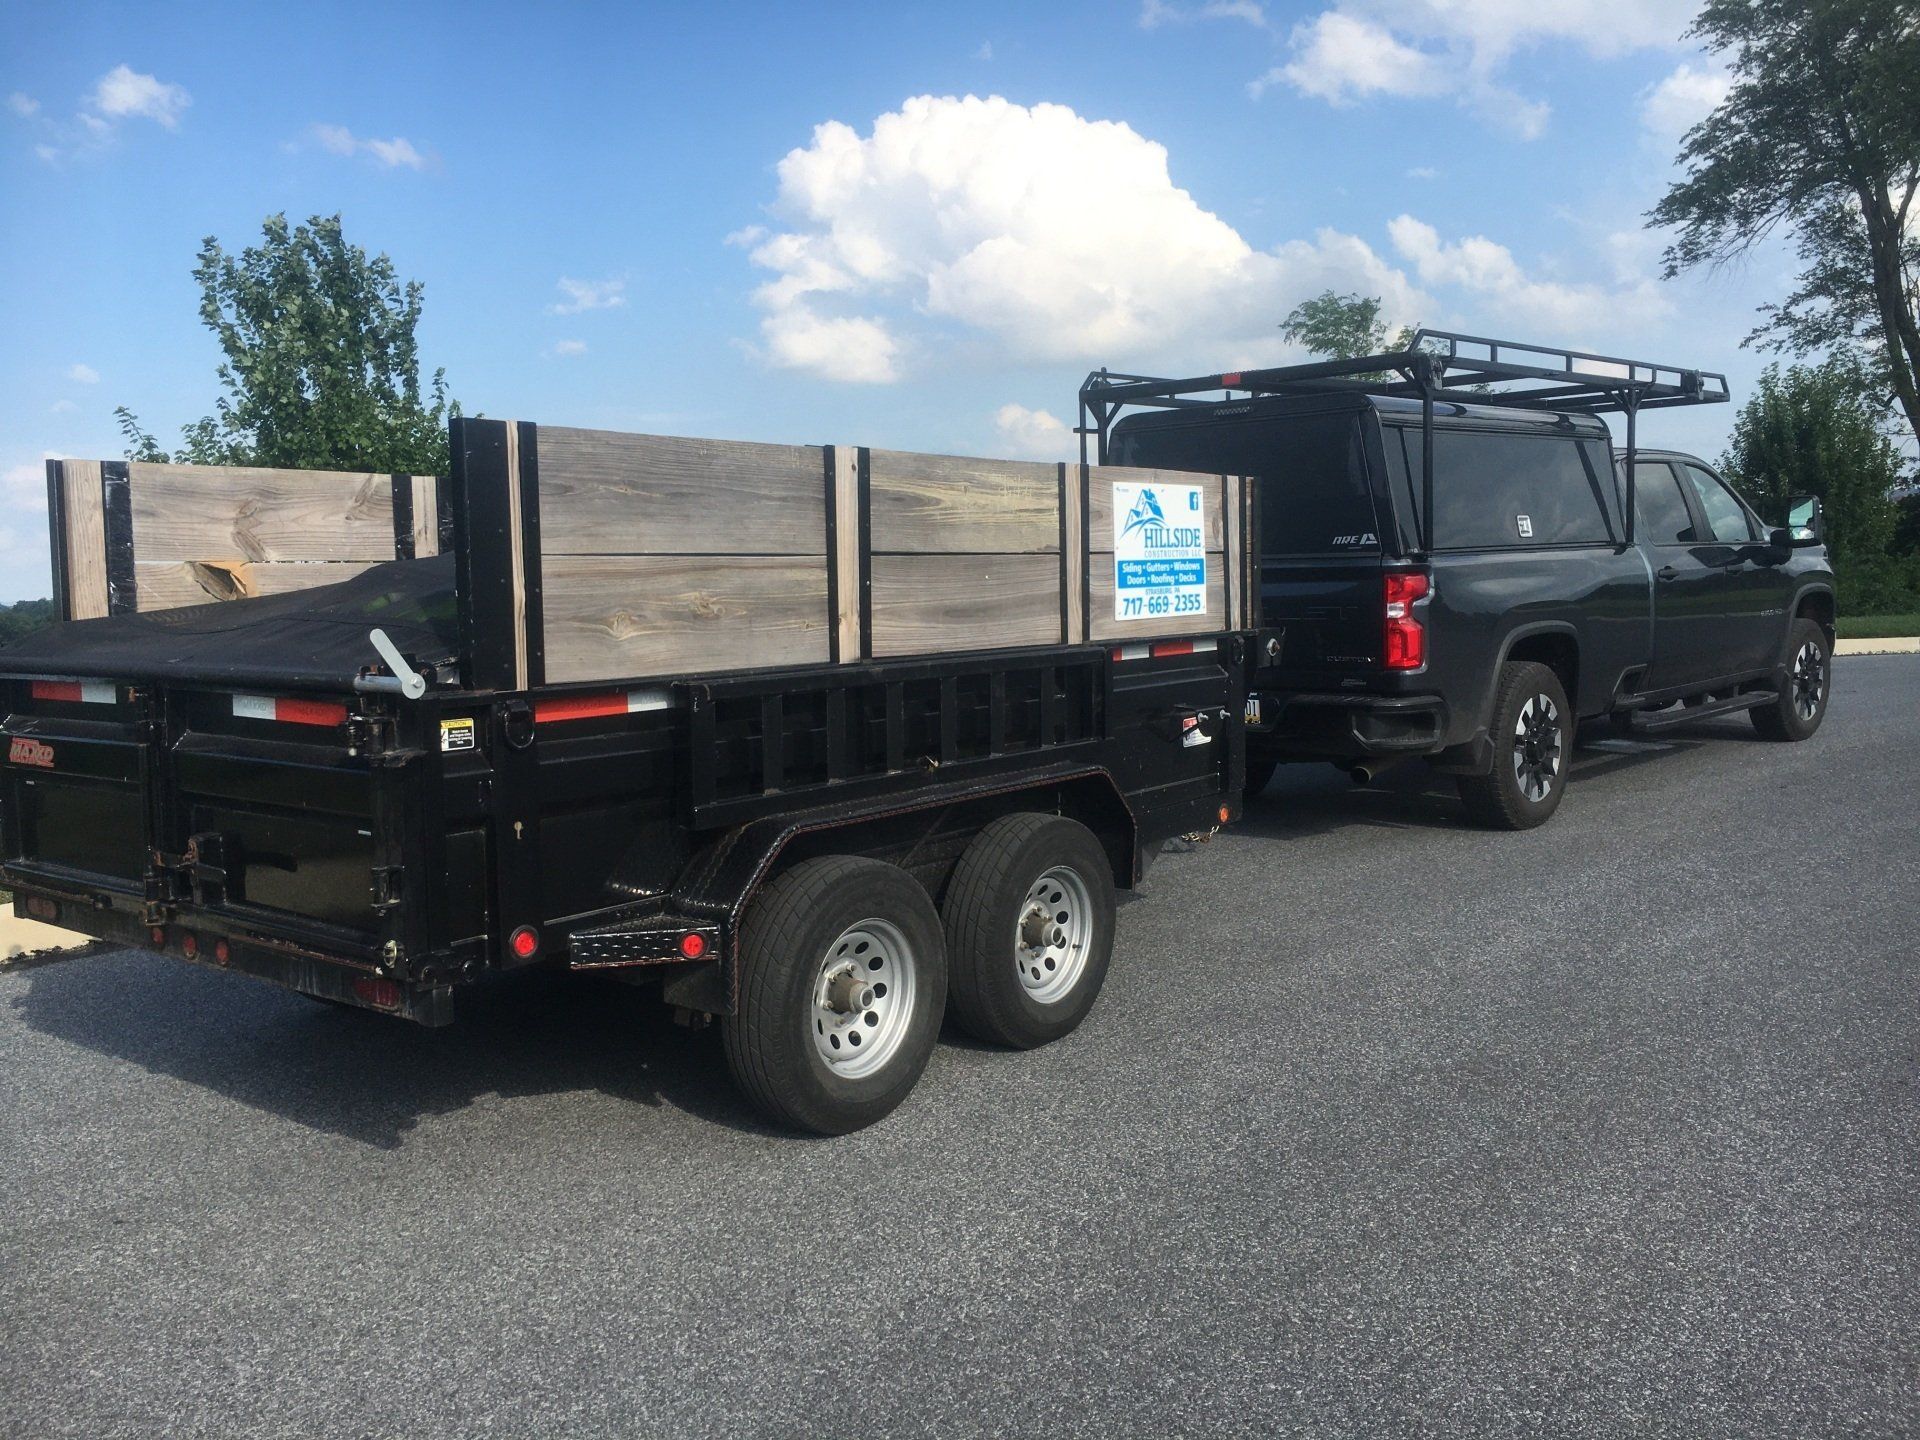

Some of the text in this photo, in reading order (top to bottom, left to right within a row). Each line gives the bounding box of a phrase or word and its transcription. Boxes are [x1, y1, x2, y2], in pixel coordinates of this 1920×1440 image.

[1144, 528, 1201, 548] HILLSIDE
[1332, 535, 1359, 545] ARE
[1144, 549, 1202, 559] CONSTRUCTION LLC
[1122, 561, 1201, 575] Siding Gutters Windows
[1127, 573, 1197, 585] Doors Roofing Decks
[1123, 594, 1201, 616] 717-669-2355
